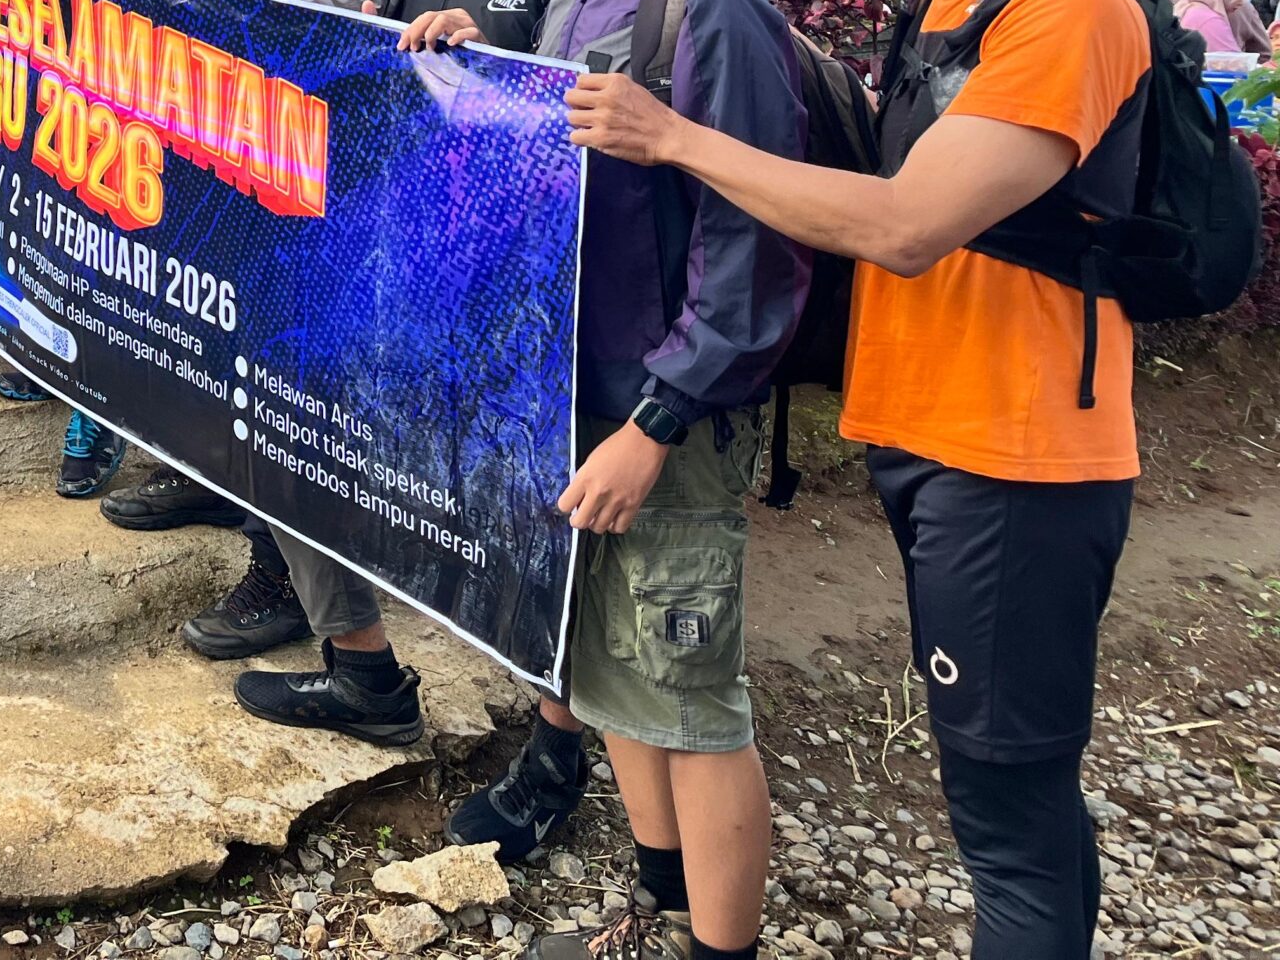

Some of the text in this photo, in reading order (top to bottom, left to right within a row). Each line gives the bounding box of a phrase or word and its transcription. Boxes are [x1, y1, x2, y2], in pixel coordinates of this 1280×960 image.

[31, 69, 164, 231] 2026
[9, 172, 21, 217] 2
[34, 189, 55, 240] 15
[54, 201, 159, 298] FEBRUARI
[165, 255, 237, 333] 2026
[20, 235, 204, 357] Penggunaan HP saat berkendara
[17, 262, 229, 401] Mengemudi dalam pengaruh alkohol
[253, 363, 374, 442] Melawan Arus
[253, 396, 320, 448] Knalpot
[323, 434, 370, 476] tidak
[253, 429, 487, 569] Menerobos lampu merah
